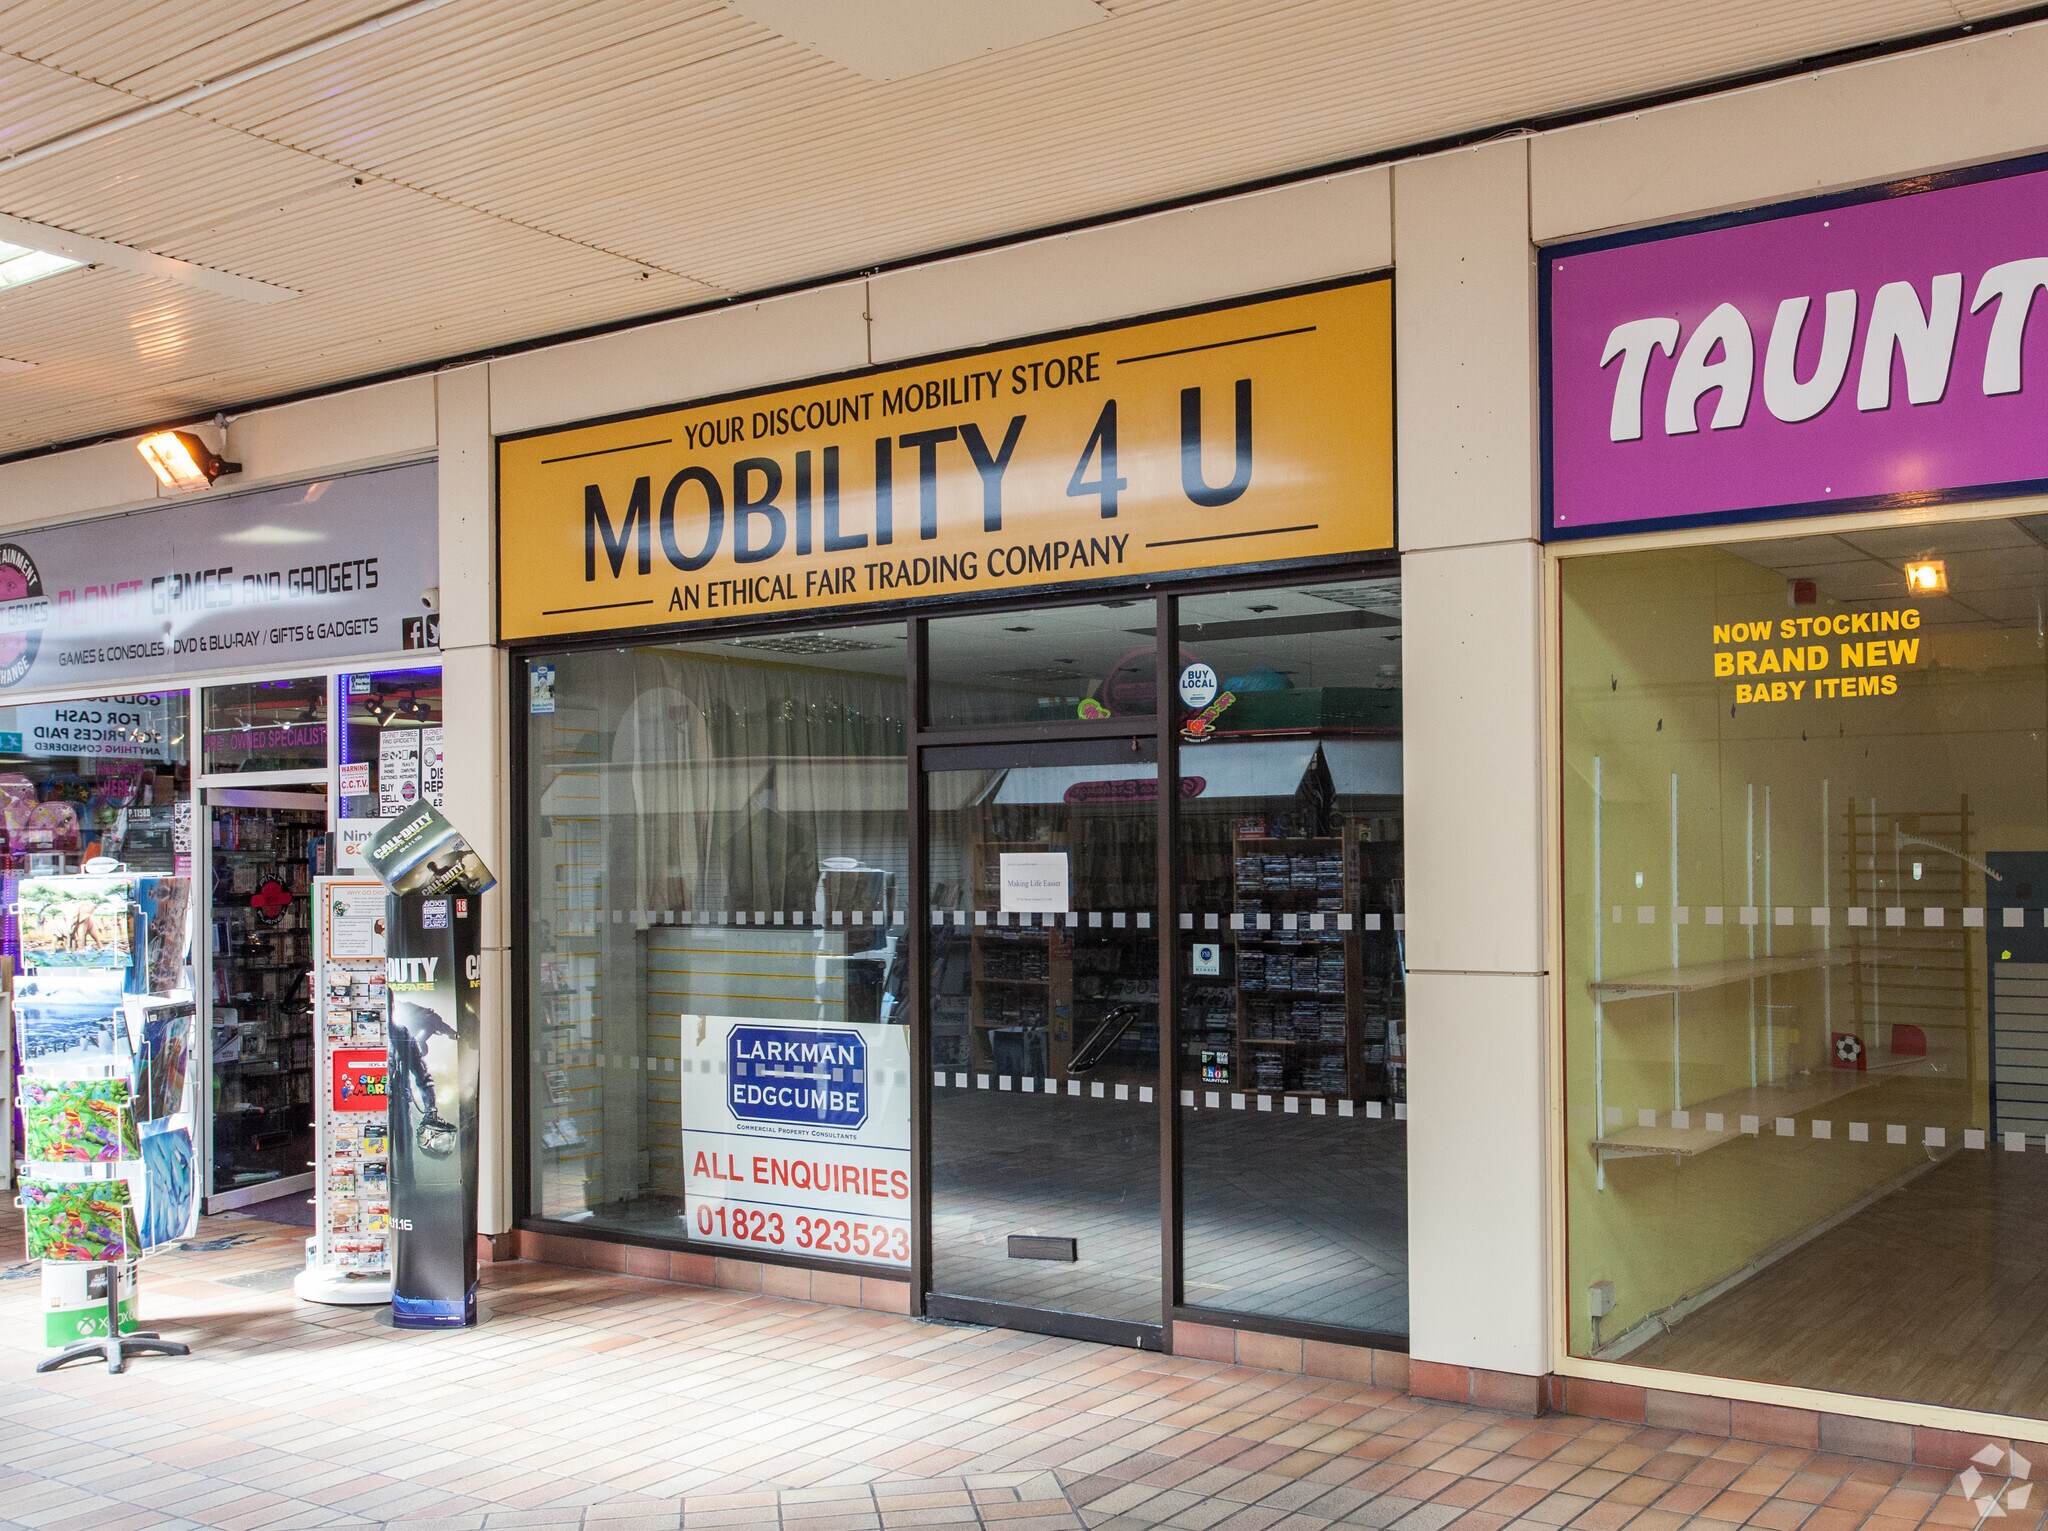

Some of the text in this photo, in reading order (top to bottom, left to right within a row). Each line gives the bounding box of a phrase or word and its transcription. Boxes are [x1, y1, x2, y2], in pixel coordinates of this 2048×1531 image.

[1600, 257, 2048, 441] TAUNT
[684, 352, 1100, 450] YOUR DISCOUNT MOBILITY STORE
[585, 378, 1252, 581] MOBILITY 4 U
[669, 534, 1129, 612] AN ETHICAL FAIR TRADING COMPANY
[58, 557, 378, 627] PLANET GAMES AND GADGETS
[1713, 609, 1921, 644] NOW STOCKING
[59, 649, 96, 667] GAMES
[107, 640, 165, 661] CONSOLES
[174, 638, 198, 655] DVD
[200, 637, 208, 651] &
[210, 630, 260, 650] BLU-RAY
[269, 624, 304, 643] GIFTS
[306, 625, 314, 640] &
[317, 617, 379, 639] GADGETS
[1714, 638, 1920, 677] BRAND NEW
[1182, 679, 1214, 688] LOCAL
[1188, 670, 1209, 679] BUY
[1736, 675, 1898, 704] BABY ITEMS
[230, 732, 265, 750] OWNED
[341, 765, 368, 773] WARNING
[341, 779, 369, 789] C.C.T.V.
[381, 783, 395, 792] BUY
[381, 795, 399, 803] SELL
[382, 804, 412, 814] EXCHAN
[372, 833, 401, 859] CALL
[401, 811, 433, 837] DUTY
[1007, 879, 1061, 888] Making Life Easier
[457, 900, 467, 911] 18
[736, 1039, 855, 1065] LARKMAN
[733, 1084, 860, 1113] EDGCUMBE
[693, 1151, 909, 1200] ALL ENQUIRIES
[697, 1204, 910, 1261] 01823 323523
